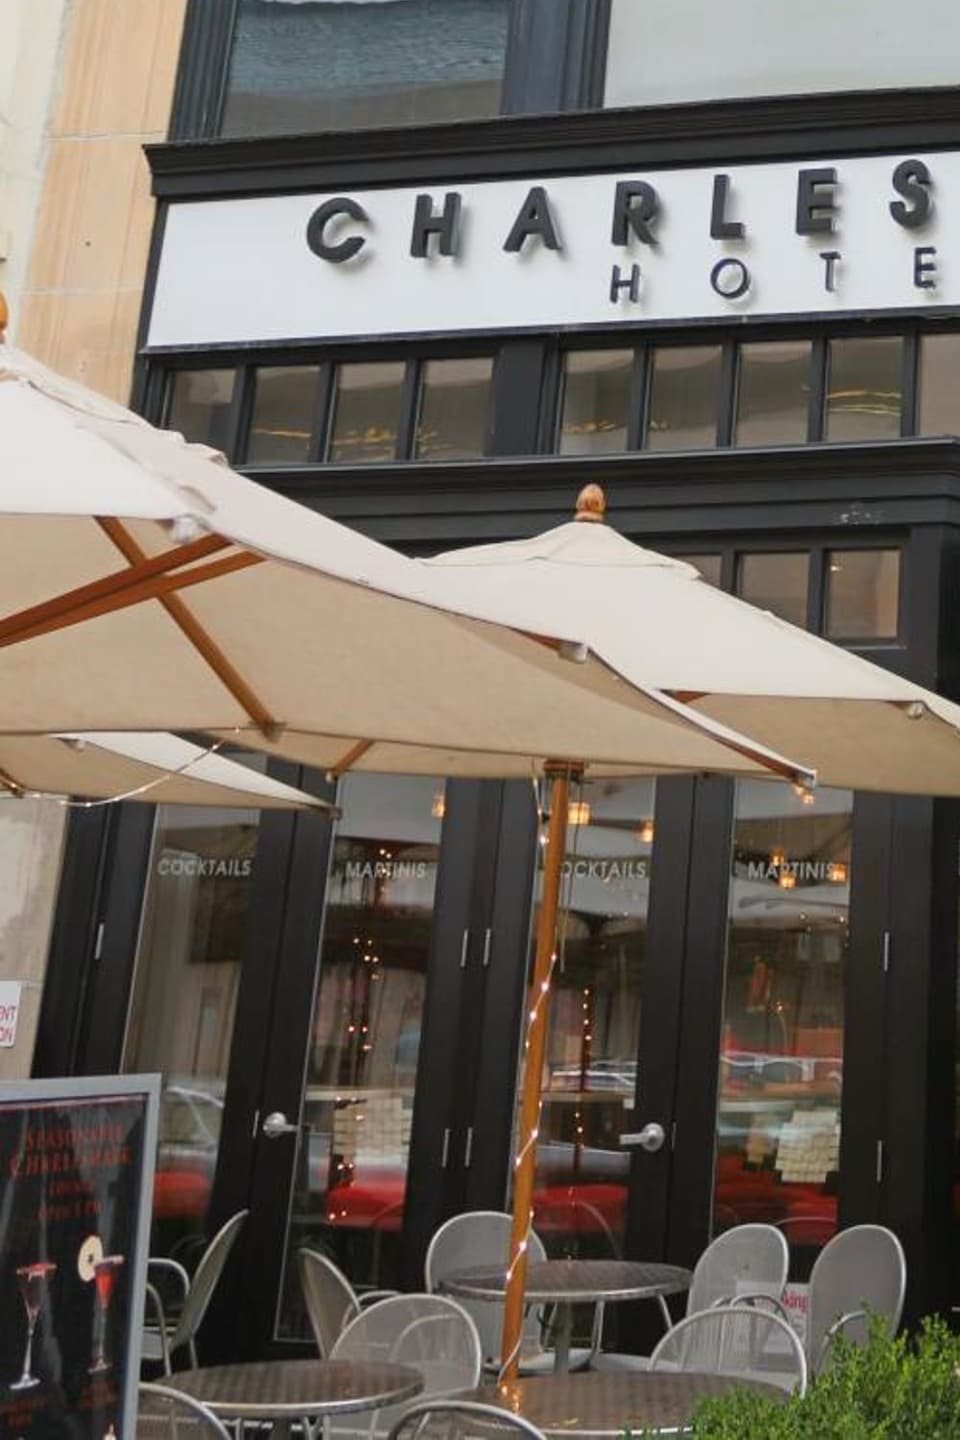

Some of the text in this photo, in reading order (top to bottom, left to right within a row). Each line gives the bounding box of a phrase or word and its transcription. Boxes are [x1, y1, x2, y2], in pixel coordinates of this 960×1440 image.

[157, 859, 252, 877] COCKTAILS
[345, 860, 427, 880] MARTINIS
[560, 859, 647, 879] OCKTAILS
[0, 1006, 17, 1021] ENT
[0, 1027, 15, 1042] ON
